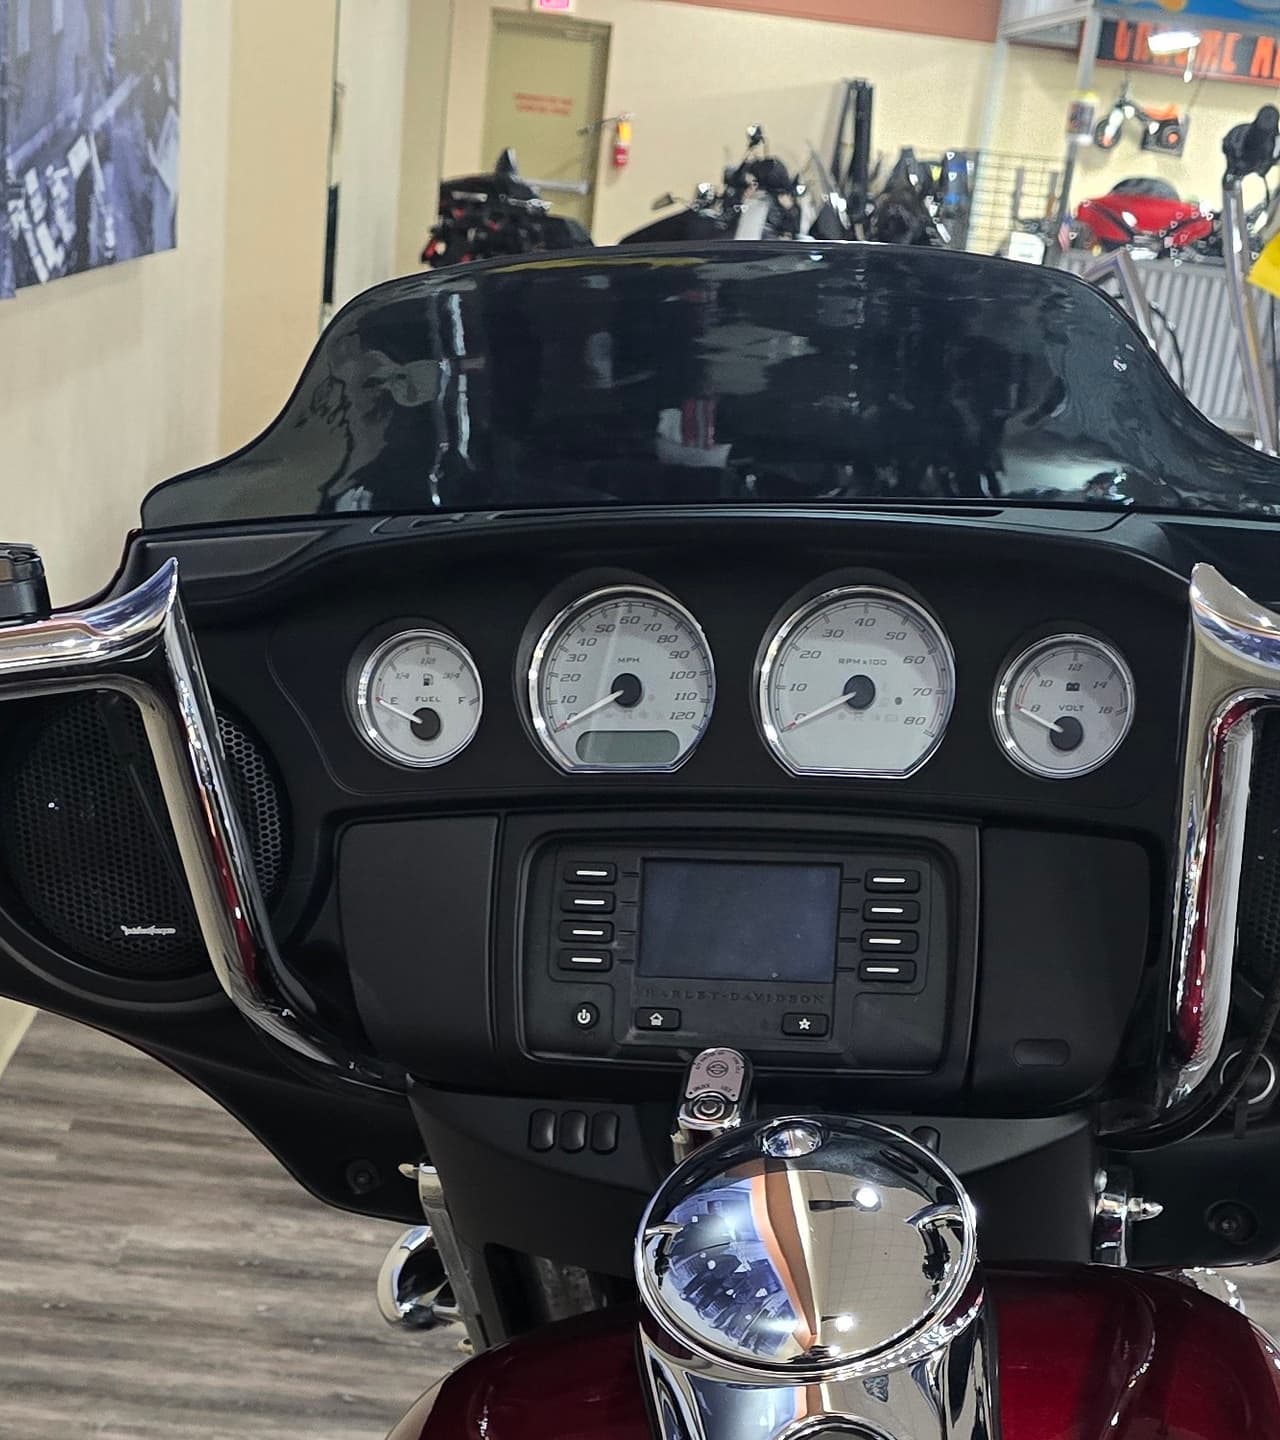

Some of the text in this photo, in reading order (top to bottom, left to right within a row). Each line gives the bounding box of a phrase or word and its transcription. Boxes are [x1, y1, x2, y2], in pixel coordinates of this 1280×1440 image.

[619, 615, 640, 625] 60
[854, 618, 877, 627] 40
[595, 624, 616, 633] 50
[642, 623, 662, 632] 70
[822, 629, 844, 638] 30
[884, 631, 907, 641] 50
[577, 638, 598, 647] 40
[657, 635, 678, 644] 80
[565, 653, 588, 663] 30
[668, 650, 690, 660] 90
[799, 650, 822, 659] 20
[902, 655, 926, 665] 60
[560, 673, 581, 682] 20
[669, 671, 697, 680] 100
[789, 683, 808, 692] 10
[1038, 679, 1054, 687] 10
[1092, 681, 1108, 689] 14
[674, 692, 697, 701] 110
[912, 687, 933, 697] 70
[458, 696, 466, 704] F
[560, 695, 578, 704] 10
[669, 711, 696, 720] 120
[903, 716, 926, 726] 80
